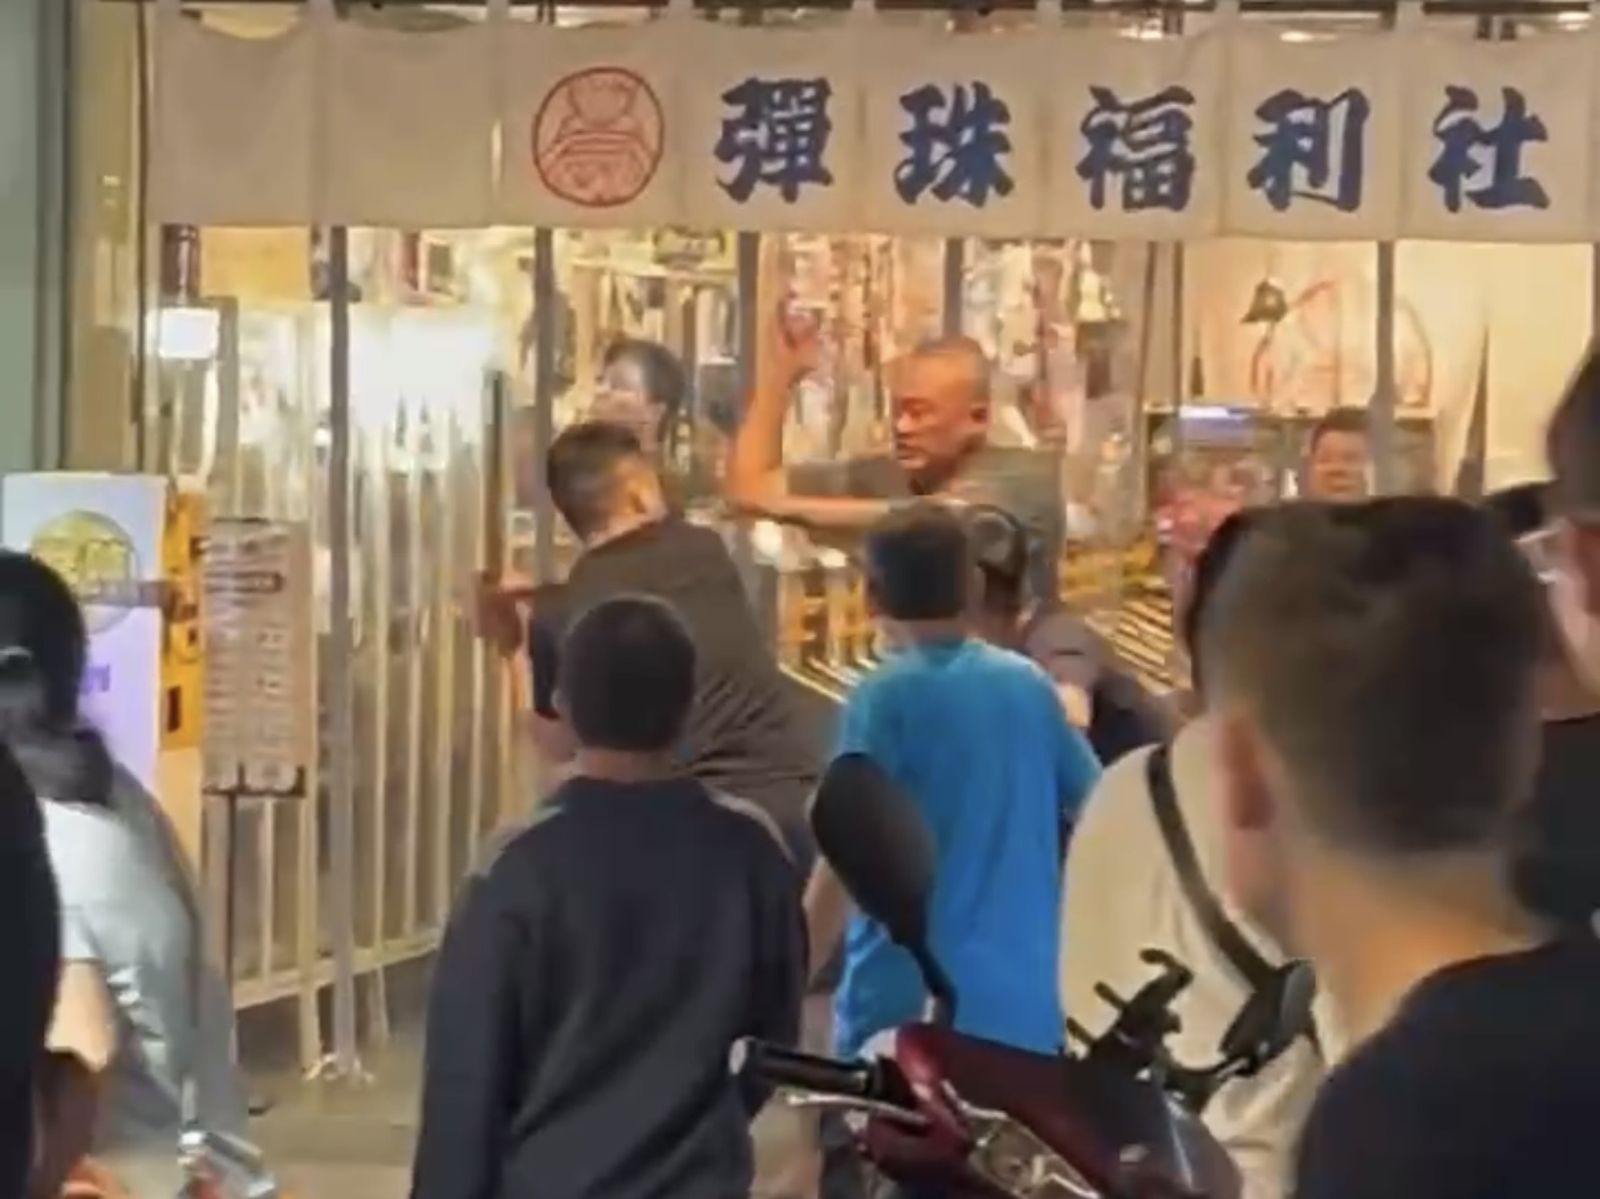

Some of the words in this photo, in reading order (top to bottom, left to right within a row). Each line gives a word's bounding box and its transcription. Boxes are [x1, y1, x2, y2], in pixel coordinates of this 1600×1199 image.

[713, 76, 1550, 213] 彈珠福利社
